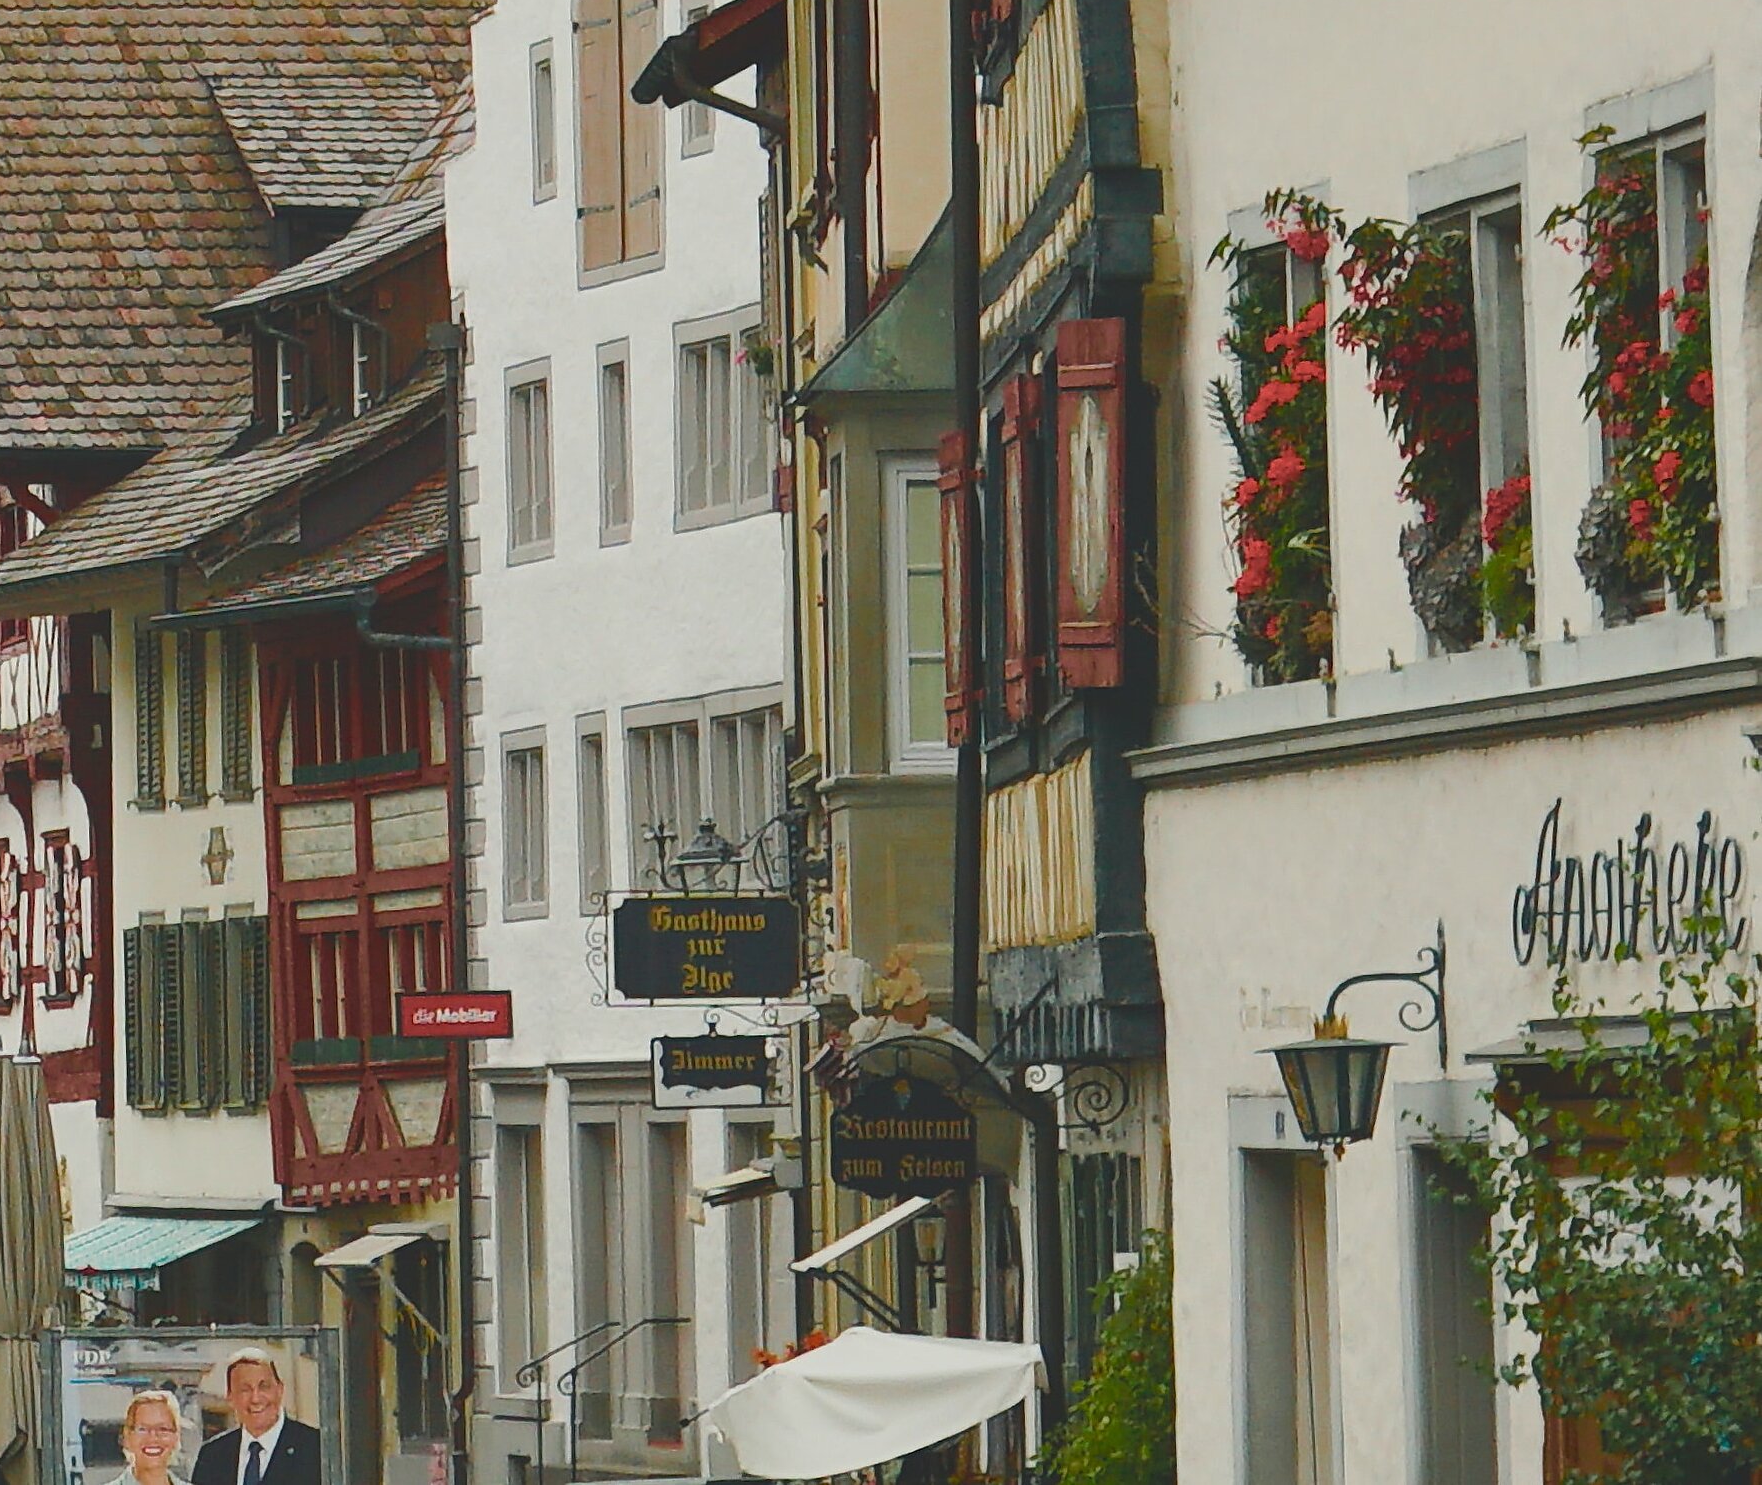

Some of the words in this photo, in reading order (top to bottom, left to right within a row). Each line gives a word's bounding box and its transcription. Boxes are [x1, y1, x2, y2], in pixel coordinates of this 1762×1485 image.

[1512, 796, 1748, 973] Apotheke
[649, 905, 766, 936] Gasthaus
[687, 938, 725, 957] zur
[412, 1007, 435, 1024] die
[436, 1007, 497, 1024] Mobiliar
[671, 1050, 756, 1070] Zimmer
[841, 1158, 883, 1181] zum
